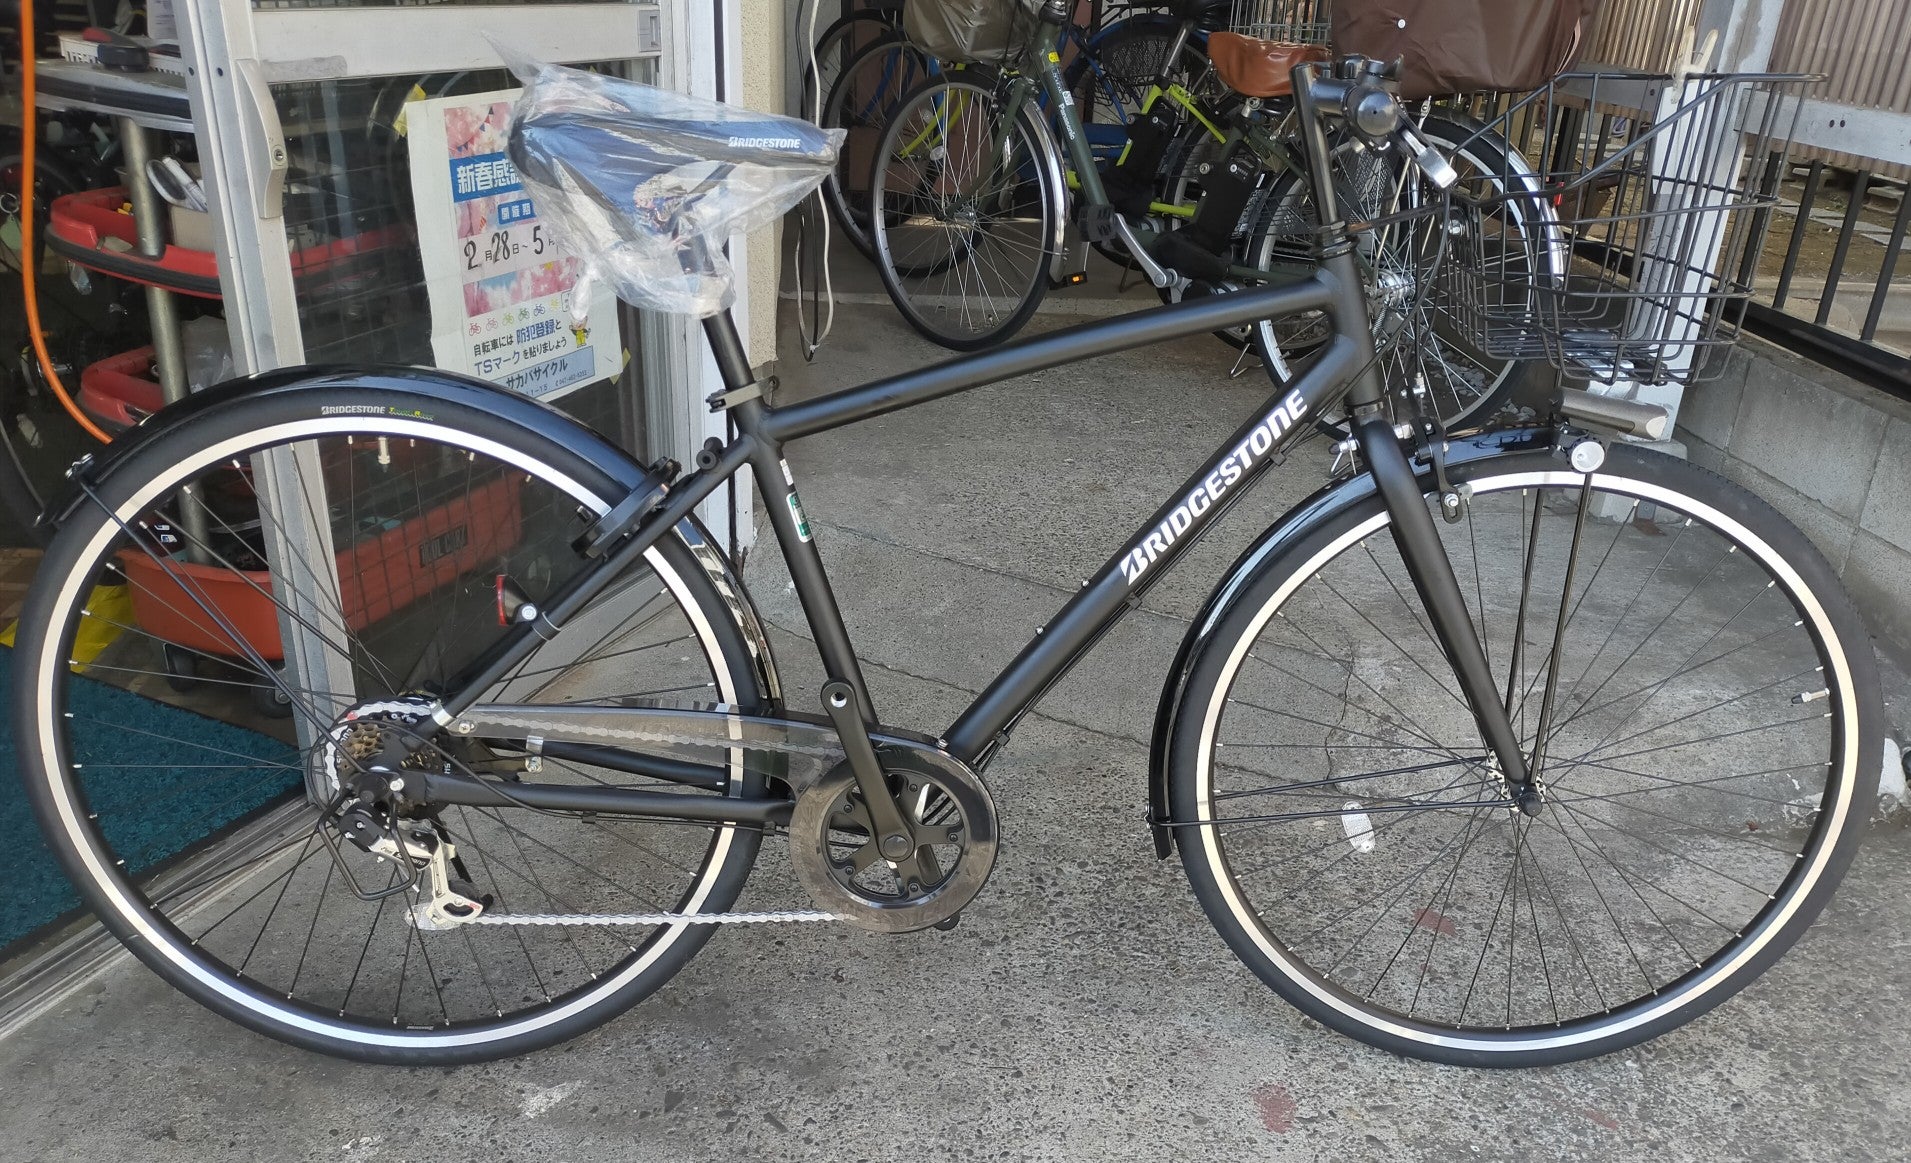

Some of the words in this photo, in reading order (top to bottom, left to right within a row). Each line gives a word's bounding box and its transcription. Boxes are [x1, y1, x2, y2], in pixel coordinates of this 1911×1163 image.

[1059, 103, 1075, 140] Panasonic
[728, 136, 801, 149] BRIDGESTONE
[321, 405, 386, 415] BRIDGESTONE
[1120, 389, 1308, 586] BRIDGESTONE
